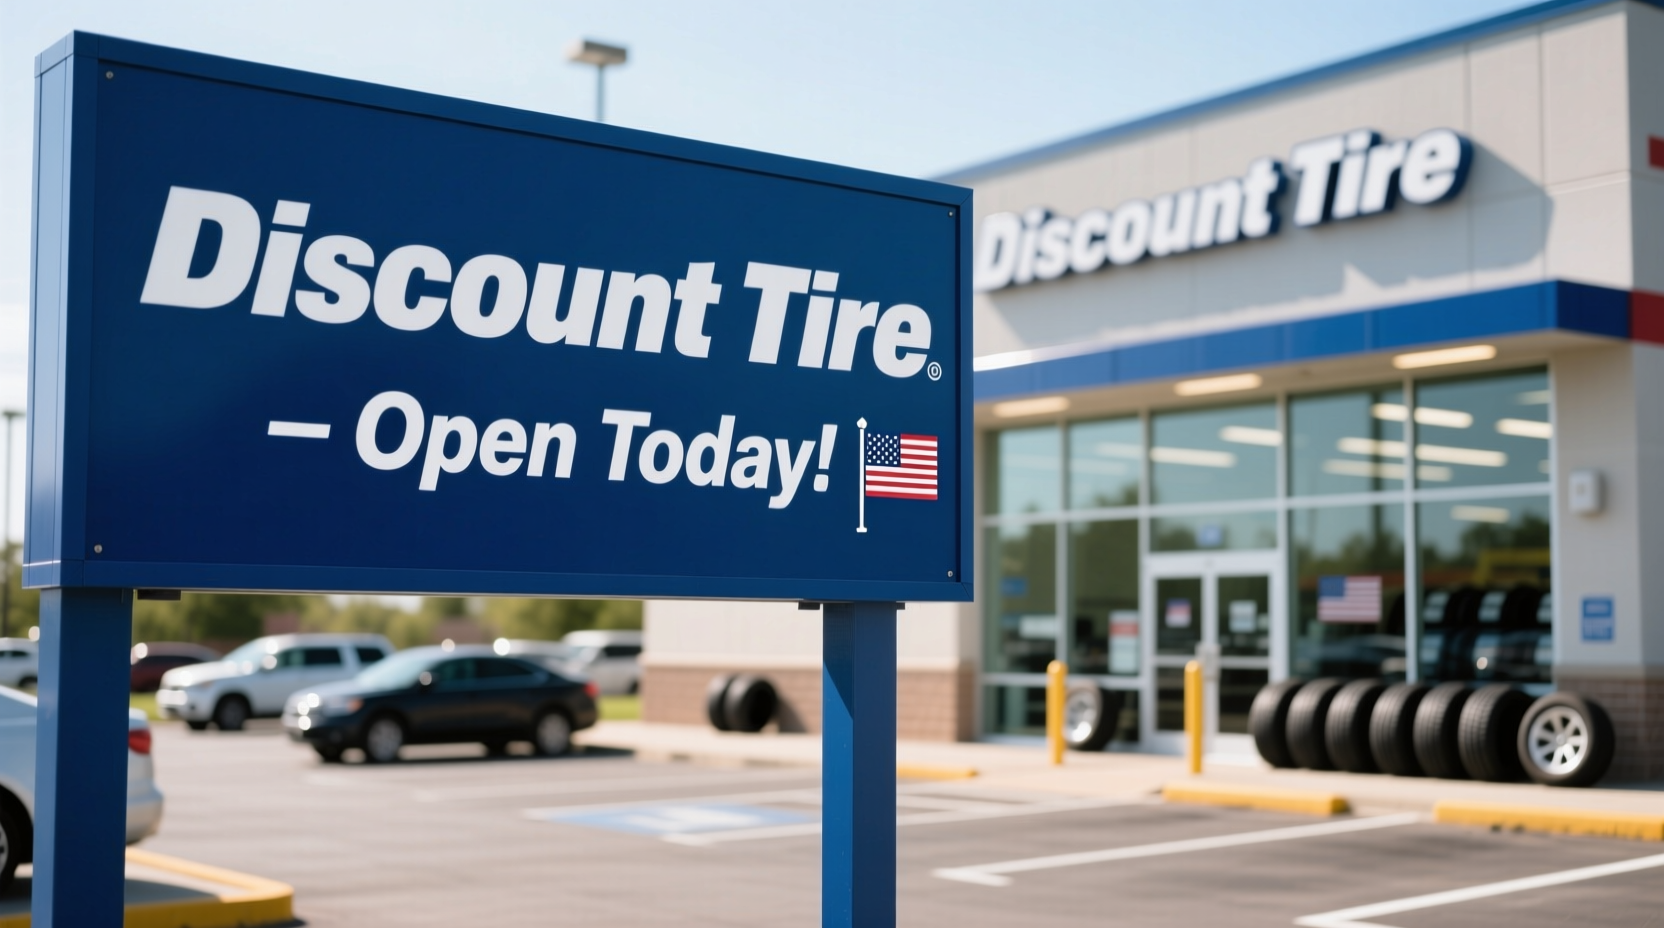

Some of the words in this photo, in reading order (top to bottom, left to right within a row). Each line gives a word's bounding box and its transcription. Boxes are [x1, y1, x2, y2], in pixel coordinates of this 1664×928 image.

[141, 187, 722, 358] Discount
[973, 155, 1280, 293] Discount
[1292, 127, 1467, 227] Tire
[356, 391, 577, 491] Open
[602, 409, 838, 509] Today!
